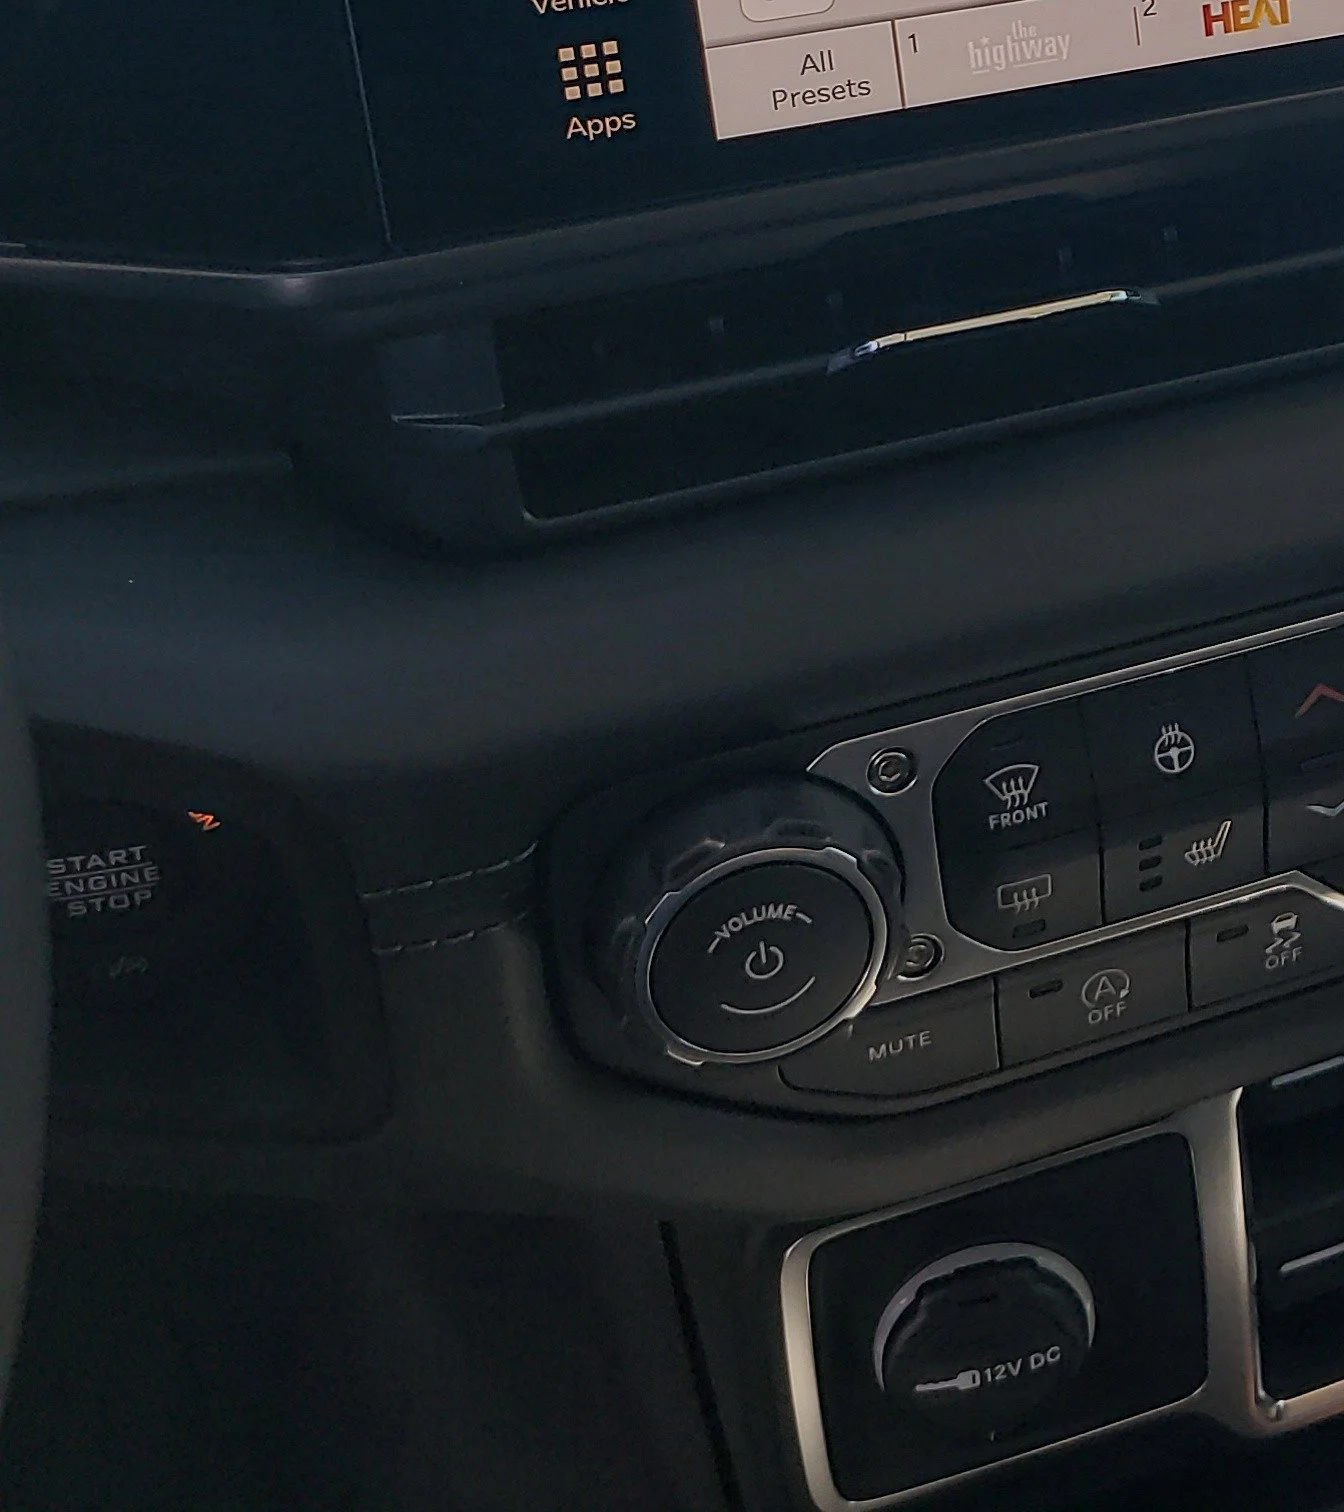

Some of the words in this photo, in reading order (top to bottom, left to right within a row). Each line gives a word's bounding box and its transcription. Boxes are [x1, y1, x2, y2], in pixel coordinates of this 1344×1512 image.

[908, 34, 919, 54] 1
[1012, 20, 1037, 39] the
[800, 50, 835, 76] All
[968, 34, 1070, 71] highway
[772, 75, 871, 111] Presets
[565, 110, 637, 141] Apps
[988, 800, 1049, 831] FRONT
[46, 846, 147, 875] START
[67, 889, 152, 917] STOP
[714, 903, 797, 938] VOLUME
[1264, 946, 1304, 971] OFF
[1086, 1000, 1127, 1026] OFF
[867, 1028, 932, 1062] MUTE
[983, 1358, 1023, 1384] 12V
[1031, 1345, 1062, 1371] DC
